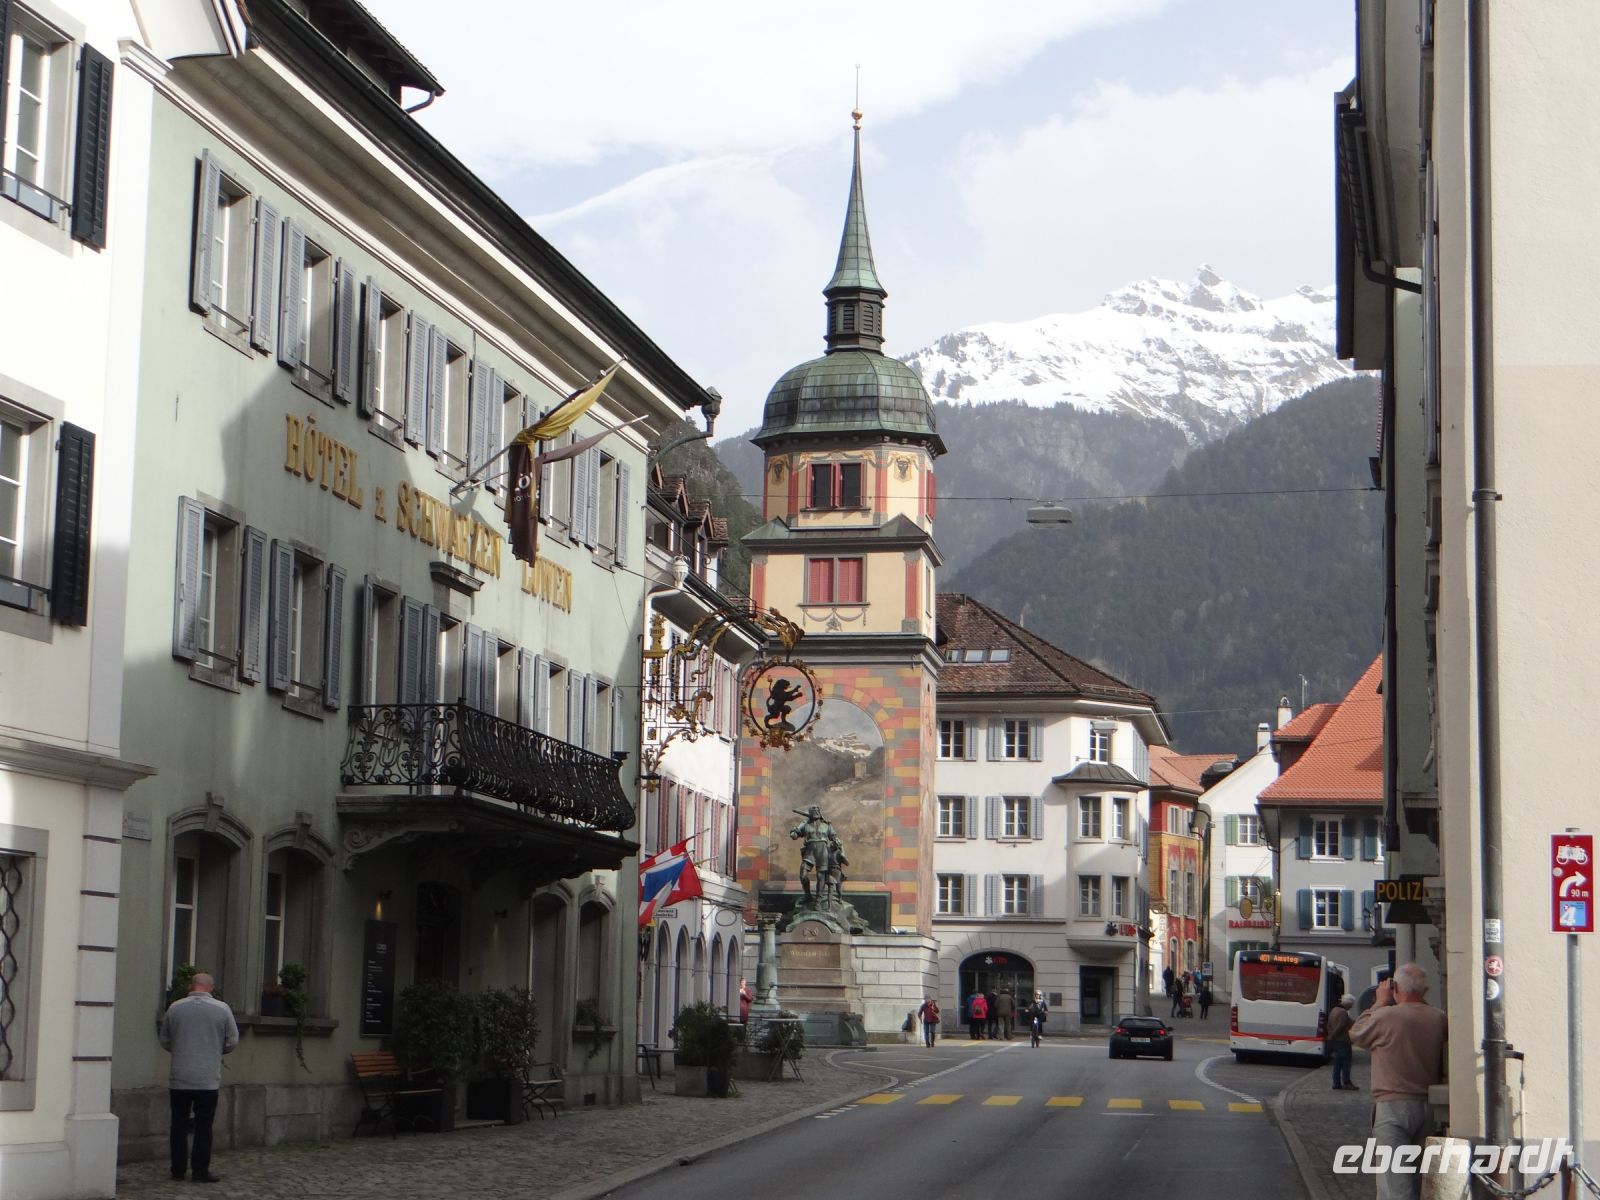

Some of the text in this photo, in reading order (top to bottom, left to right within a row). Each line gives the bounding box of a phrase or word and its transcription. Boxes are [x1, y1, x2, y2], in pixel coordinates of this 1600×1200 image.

[284, 413, 363, 509] HÔTEL
[396, 480, 502, 579] SCHWARZEN
[1376, 881, 1422, 901] POLIZ
[1570, 889, 1580, 897] 90
